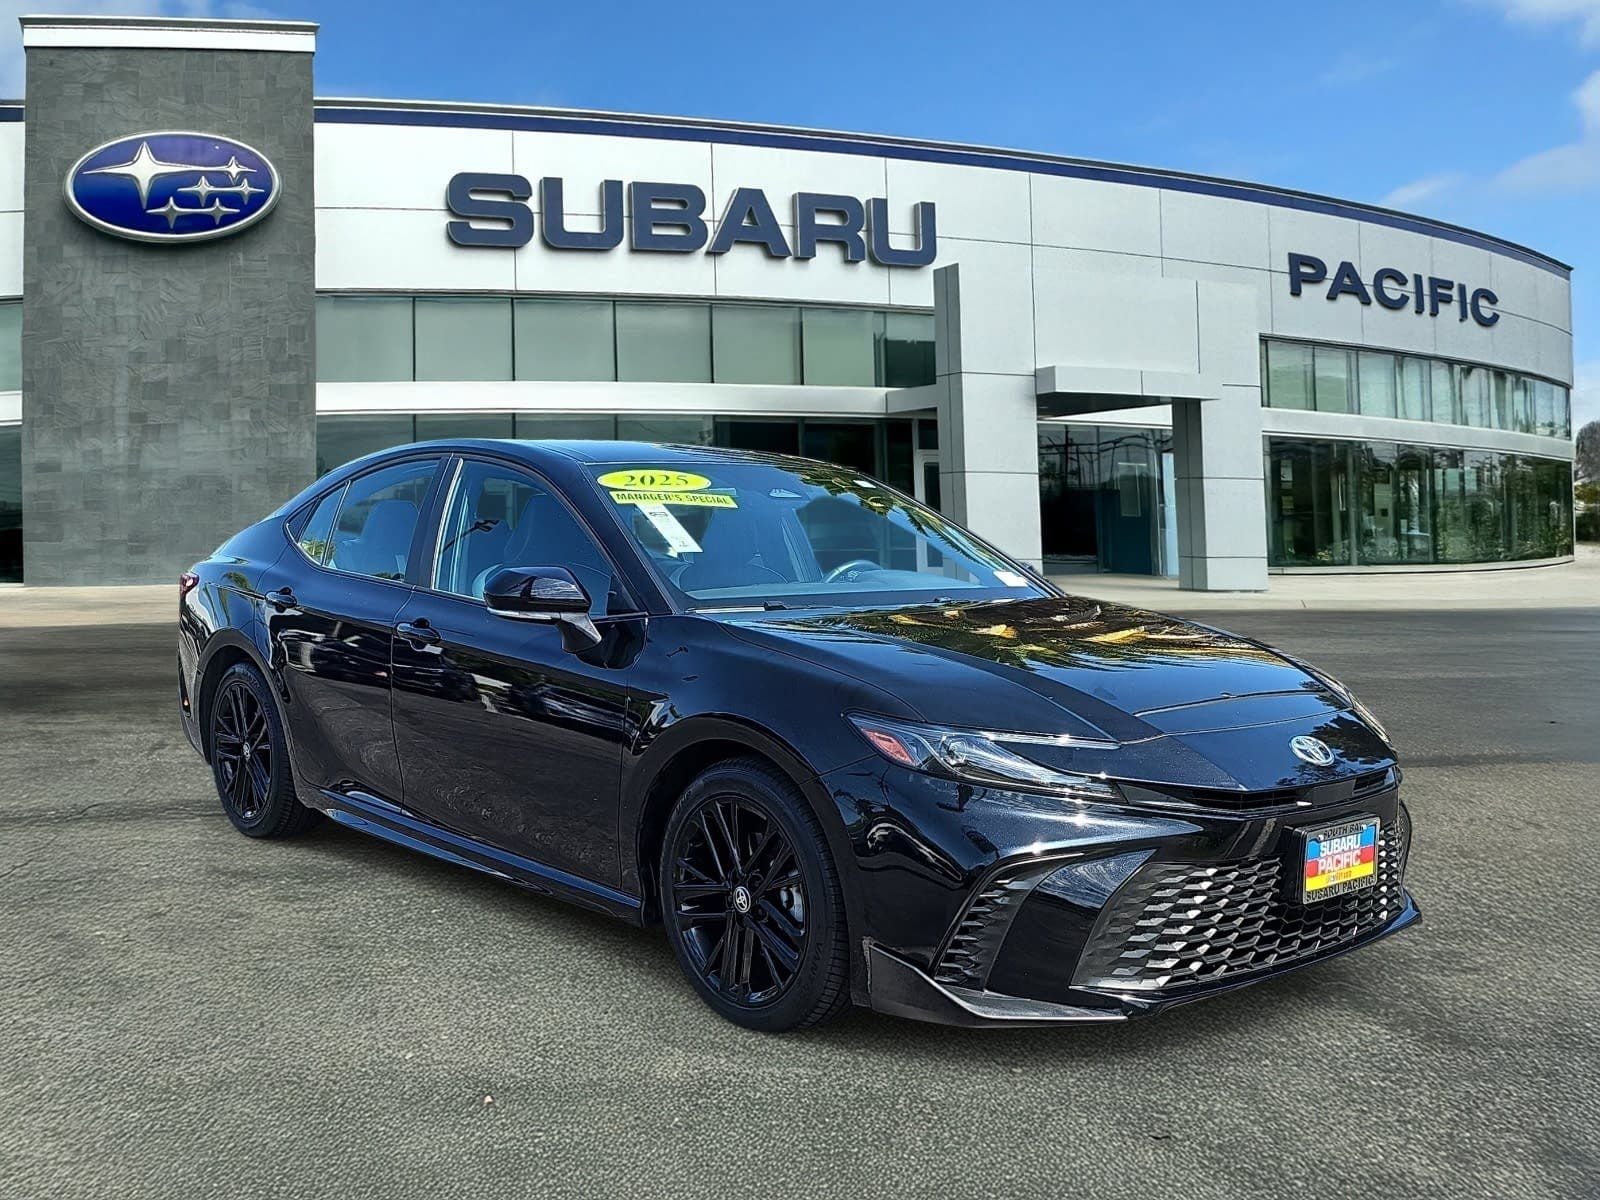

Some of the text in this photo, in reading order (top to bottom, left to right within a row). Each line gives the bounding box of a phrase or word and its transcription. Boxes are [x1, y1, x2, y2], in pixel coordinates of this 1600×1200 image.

[446, 172, 937, 268] SUBARU
[1288, 252, 1500, 327] PACIFIC
[623, 474, 690, 487] 2025
[616, 493, 731, 505] MANAGER'S SPECIAL
[1324, 826, 1348, 837] SOUTH
[1320, 834, 1361, 857] SUBARU
[1317, 849, 1361, 874] PACIFIC
[1306, 884, 1340, 902] SUBARU
[1343, 875, 1375, 892] PACIFIC
